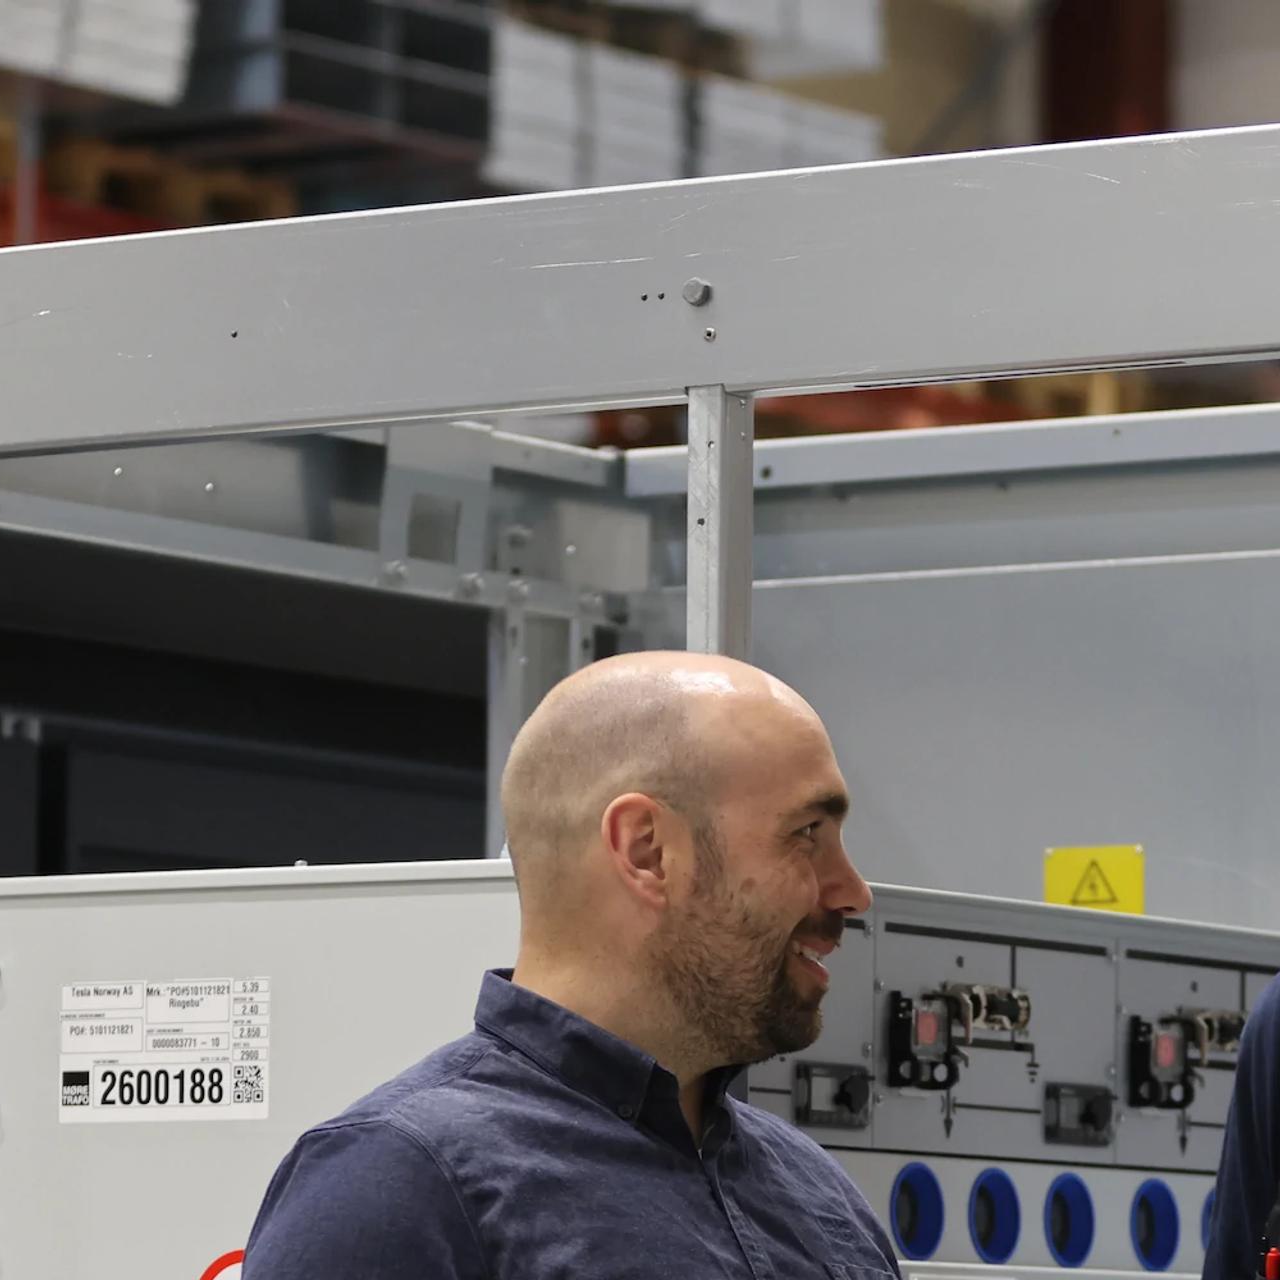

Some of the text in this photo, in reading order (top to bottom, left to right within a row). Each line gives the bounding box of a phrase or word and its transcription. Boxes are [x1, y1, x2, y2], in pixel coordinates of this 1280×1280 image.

[71, 985, 133, 998] Tesla Norway AS
[100, 1068, 224, 1106] 2600188
